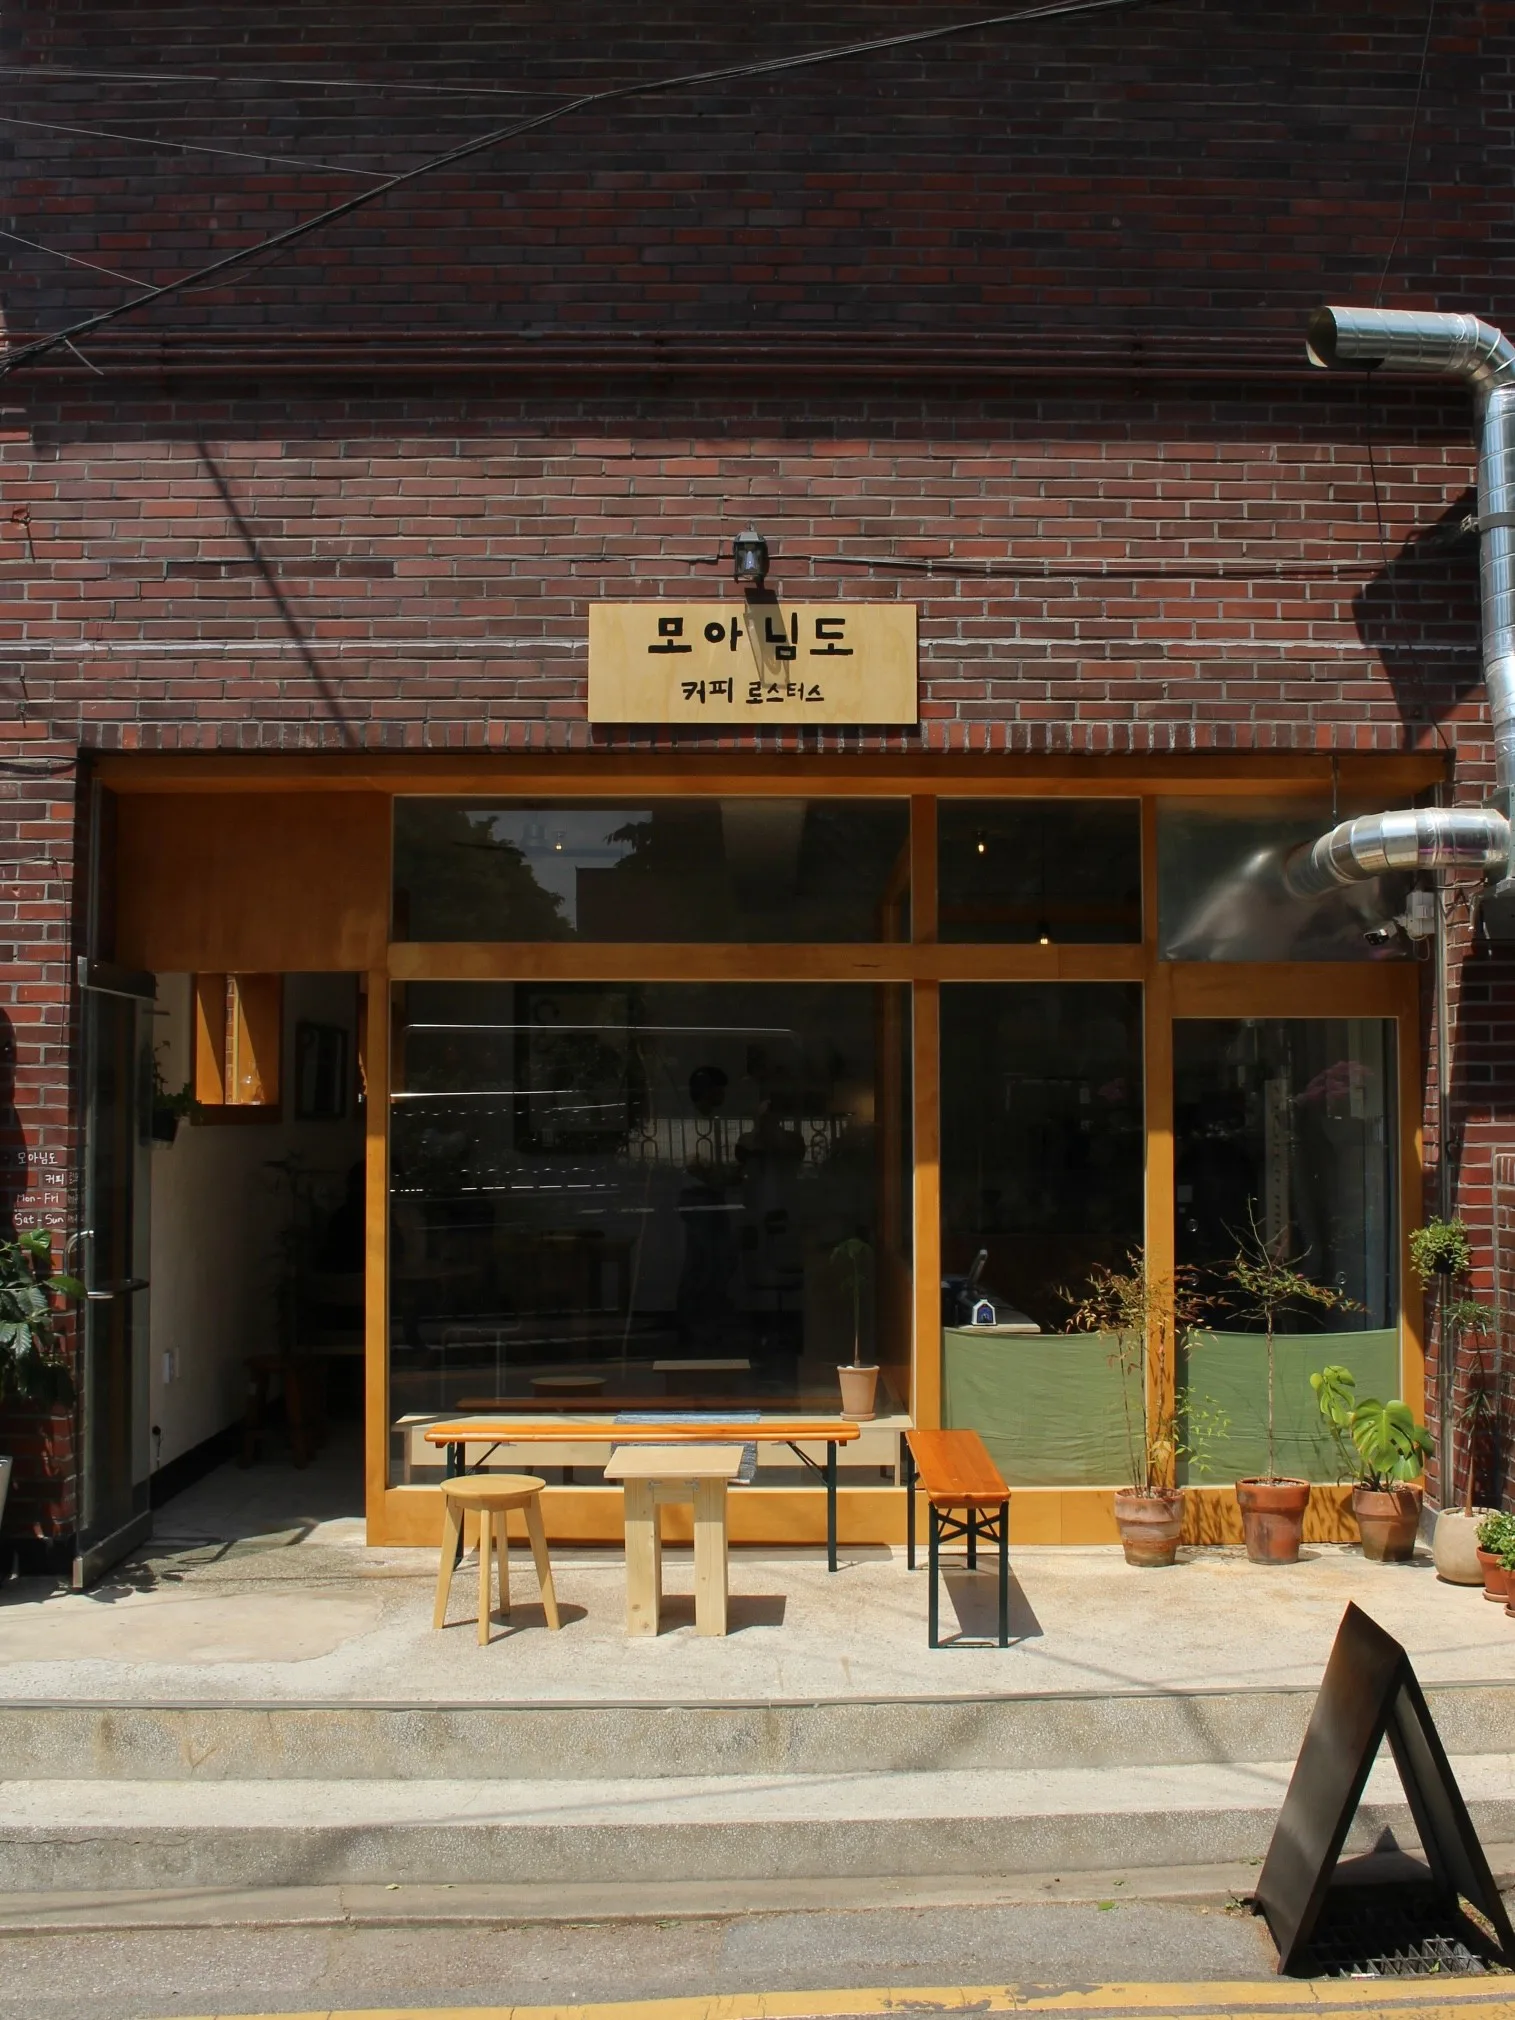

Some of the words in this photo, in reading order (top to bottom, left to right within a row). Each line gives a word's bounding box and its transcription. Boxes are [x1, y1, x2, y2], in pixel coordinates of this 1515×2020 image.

[681, 677, 733, 703] 커피
[745, 680, 825, 704] 로스터스
[44, 1173, 65, 1185] 커피
